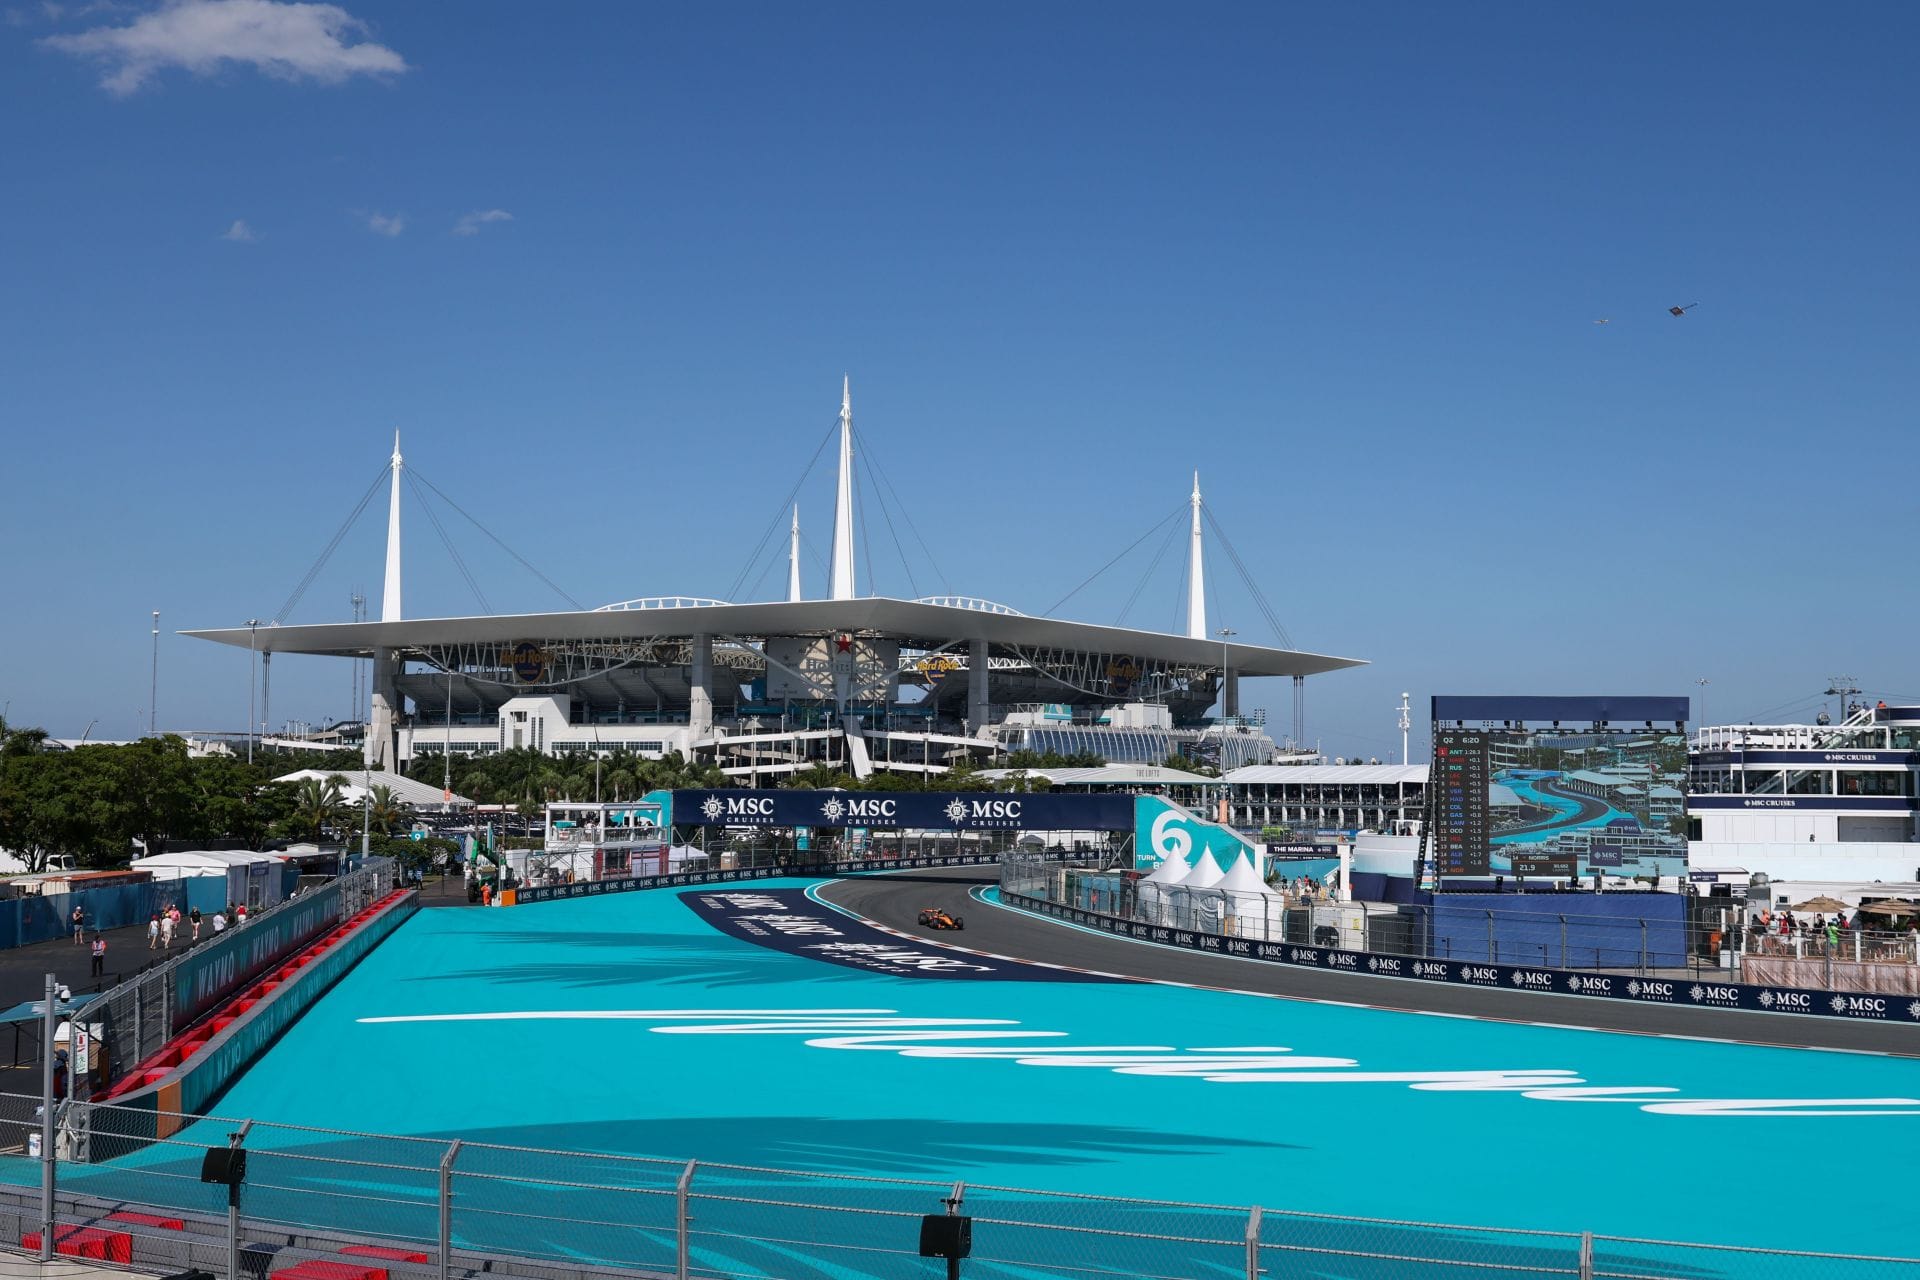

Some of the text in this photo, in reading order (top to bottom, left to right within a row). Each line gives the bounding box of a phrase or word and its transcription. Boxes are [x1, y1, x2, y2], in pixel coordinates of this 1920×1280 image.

[918, 660, 938, 670] Hard
[727, 798, 774, 815] MSC
[848, 800, 896, 817] MSC
[971, 800, 1021, 818] MSC
[1151, 810, 1192, 860] 6
[1137, 926, 1147, 936] MSC
[1157, 930, 1168, 939] MSC
[1180, 934, 1193, 944] MSC
[1206, 938, 1220, 948] MSC
[253, 926, 279, 966] WAYMO
[1235, 942, 1250, 952] MSC
[1265, 945, 1282, 956] MSC
[1300, 950, 1317, 961] MSC
[1337, 954, 1357, 966] MSC
[1379, 958, 1400, 970] MSC
[1424, 963, 1447, 975] MSC
[199, 951, 234, 1002] WAYMO
[1424, 973, 1447, 981] CRUISES
[1473, 967, 1498, 980] MSC
[1525, 972, 1552, 985] MSC
[1473, 978, 1498, 986] CRUISES
[1582, 977, 1611, 990] MSC
[1582, 988, 1611, 996] CRUISES
[1642, 982, 1673, 996] MSC
[1707, 987, 1739, 1001] MSC
[1642, 994, 1673, 1002] CRUISES
[1707, 999, 1739, 1007] CRUISES
[1776, 992, 1810, 1007] MSC
[1776, 1005, 1811, 1013] CRUISES
[1849, 997, 1886, 1012] MSC
